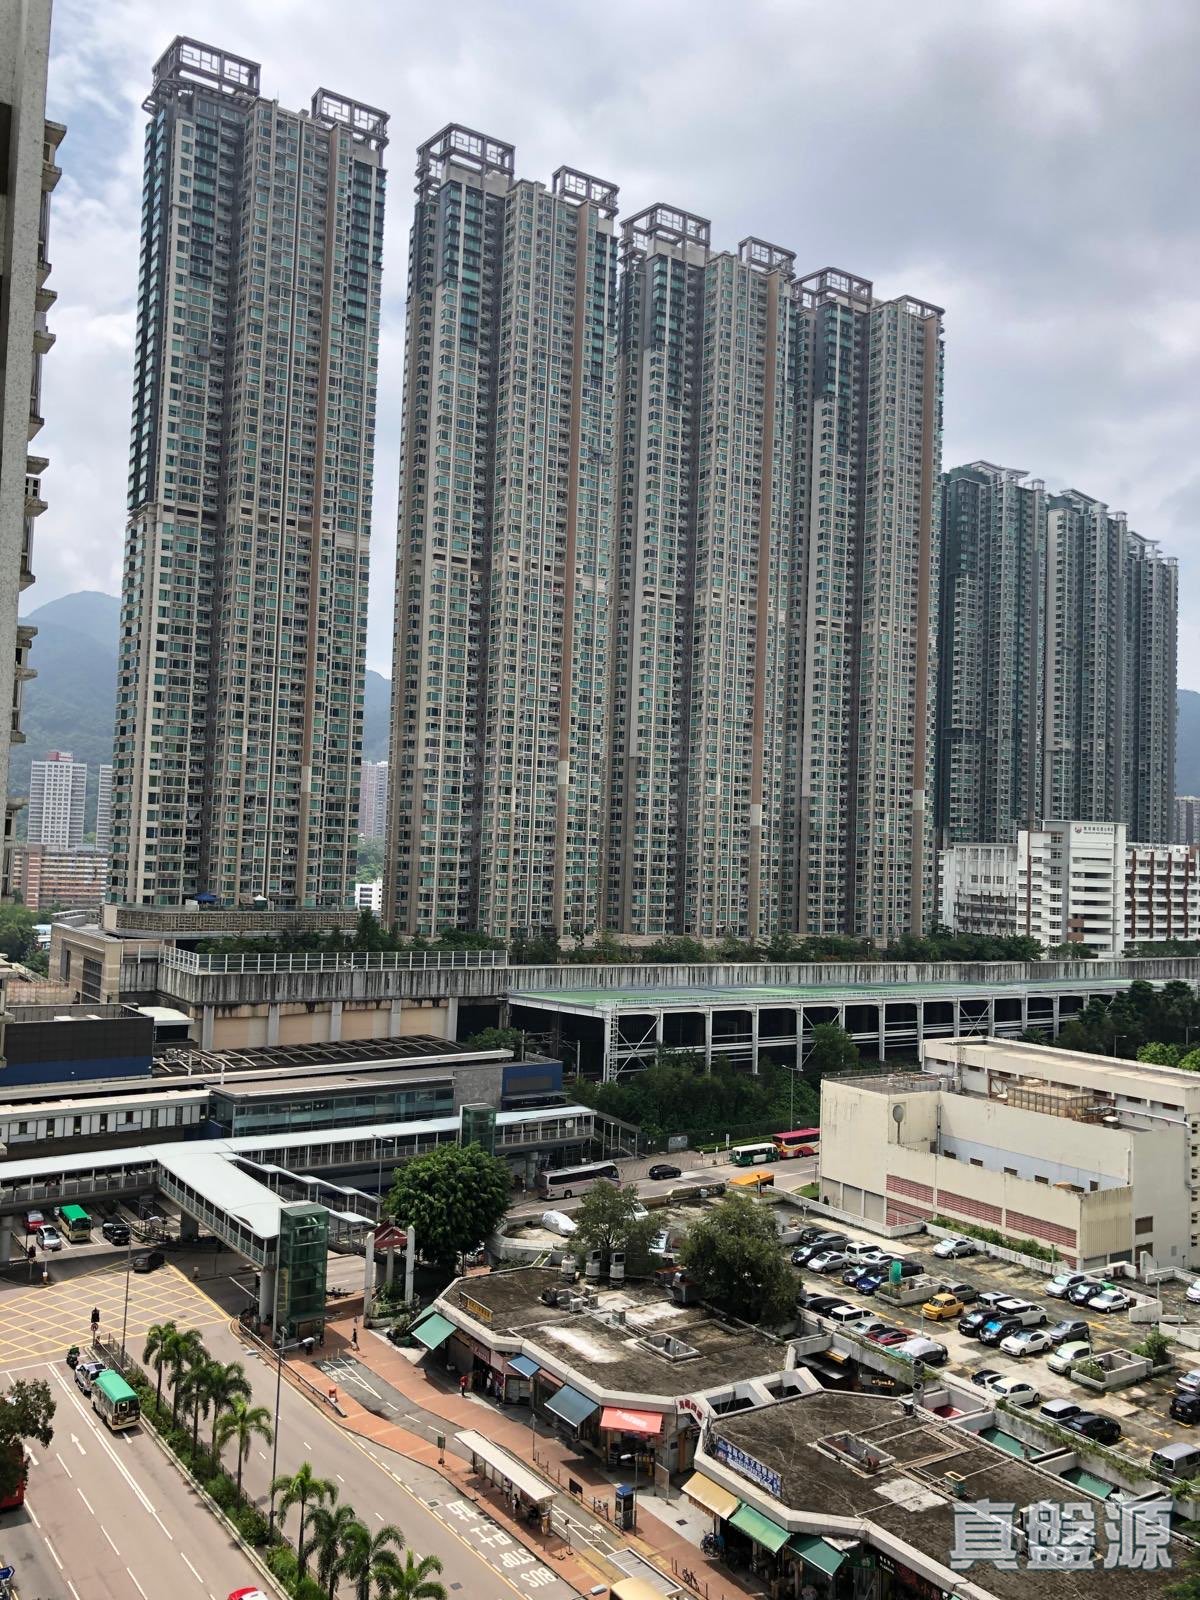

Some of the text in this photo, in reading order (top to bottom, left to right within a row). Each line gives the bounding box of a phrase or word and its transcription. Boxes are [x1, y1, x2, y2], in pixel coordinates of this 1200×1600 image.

[470, 1523, 513, 1548] 巴士
[499, 1548, 537, 1568] STOP
[520, 1566, 558, 1588] BUS
